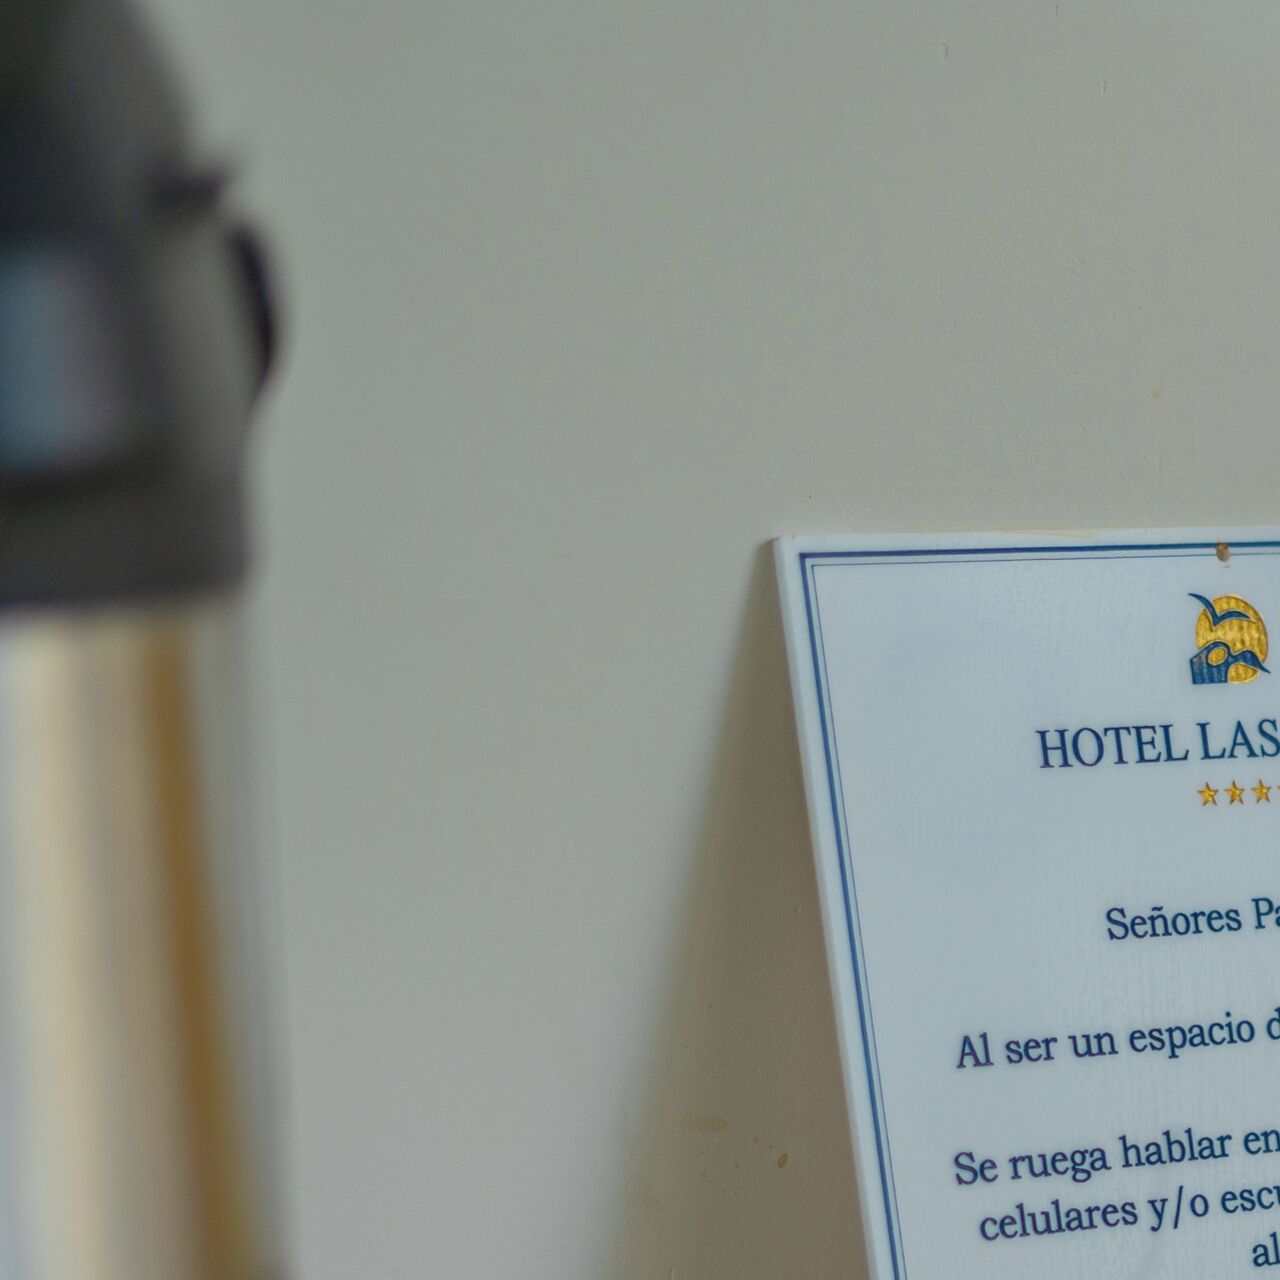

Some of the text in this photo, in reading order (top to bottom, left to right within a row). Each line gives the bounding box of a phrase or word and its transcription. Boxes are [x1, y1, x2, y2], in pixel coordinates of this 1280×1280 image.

[1035, 724, 1189, 768] HOTEL
[1196, 719, 1280, 760] LAS
[1106, 906, 1242, 940] Señores
[957, 1032, 993, 1068] Al
[1005, 1037, 1057, 1064] ser
[1068, 1032, 1118, 1057] un
[1129, 1012, 1255, 1059] espacio
[954, 1152, 998, 1185] Se
[1009, 1148, 1111, 1185] ruega
[1119, 1128, 1232, 1168] hablar
[980, 1199, 1138, 1241] celulares
[1148, 1186, 1209, 1232] y/o
